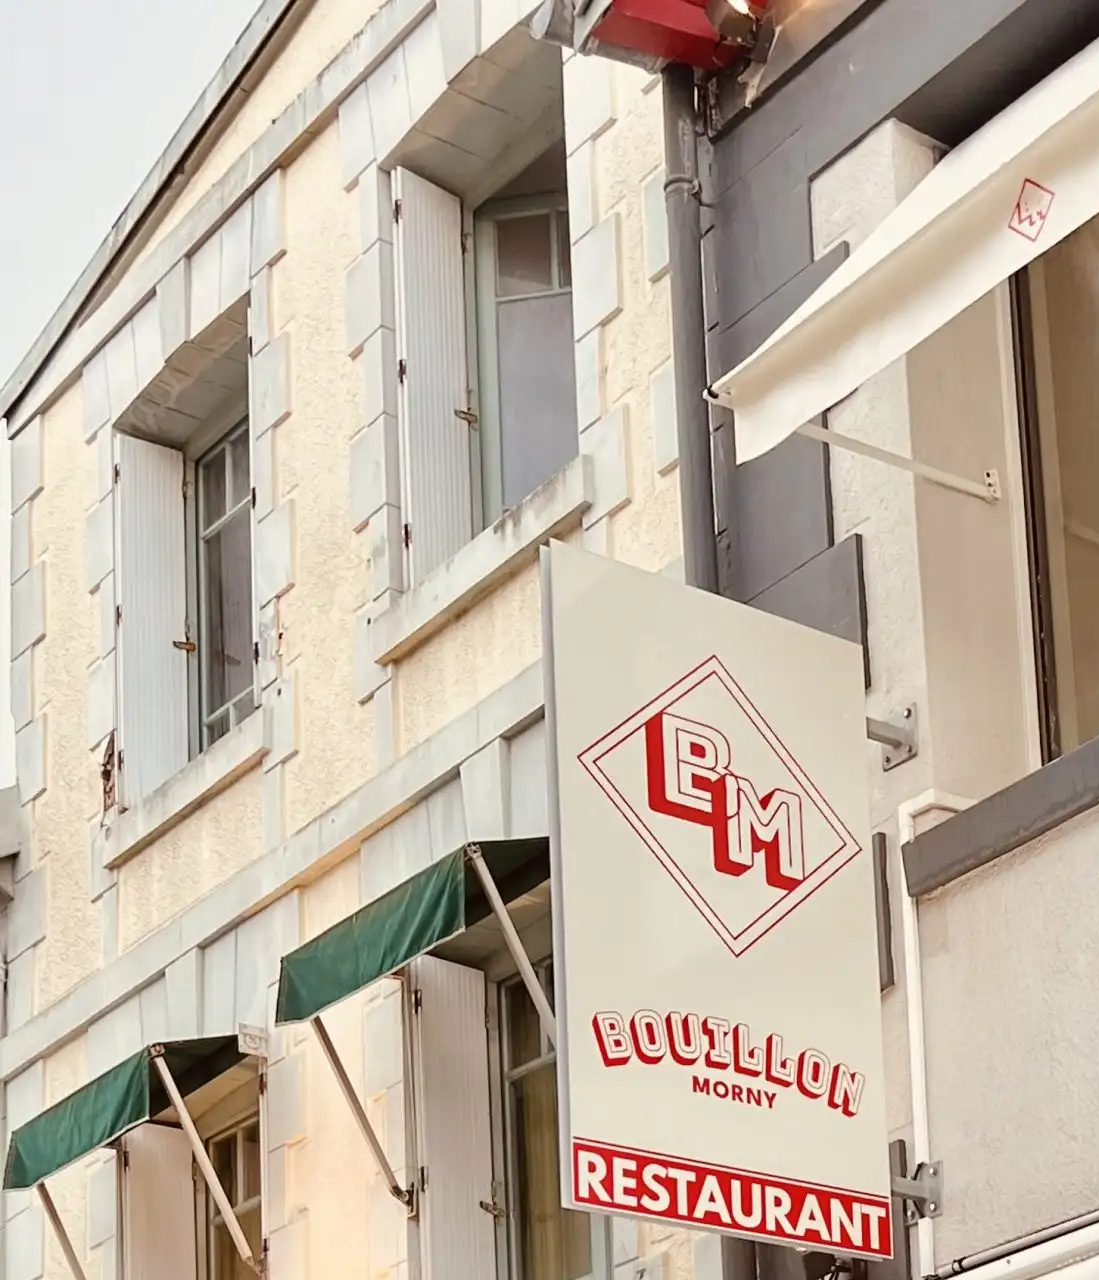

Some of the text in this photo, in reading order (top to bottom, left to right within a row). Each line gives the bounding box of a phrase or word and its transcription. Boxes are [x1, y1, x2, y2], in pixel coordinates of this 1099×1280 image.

[592, 1009, 866, 1118] BOUILLON
[692, 1075, 777, 1109] MORNY
[577, 1149, 887, 1250] RESTAURANT
